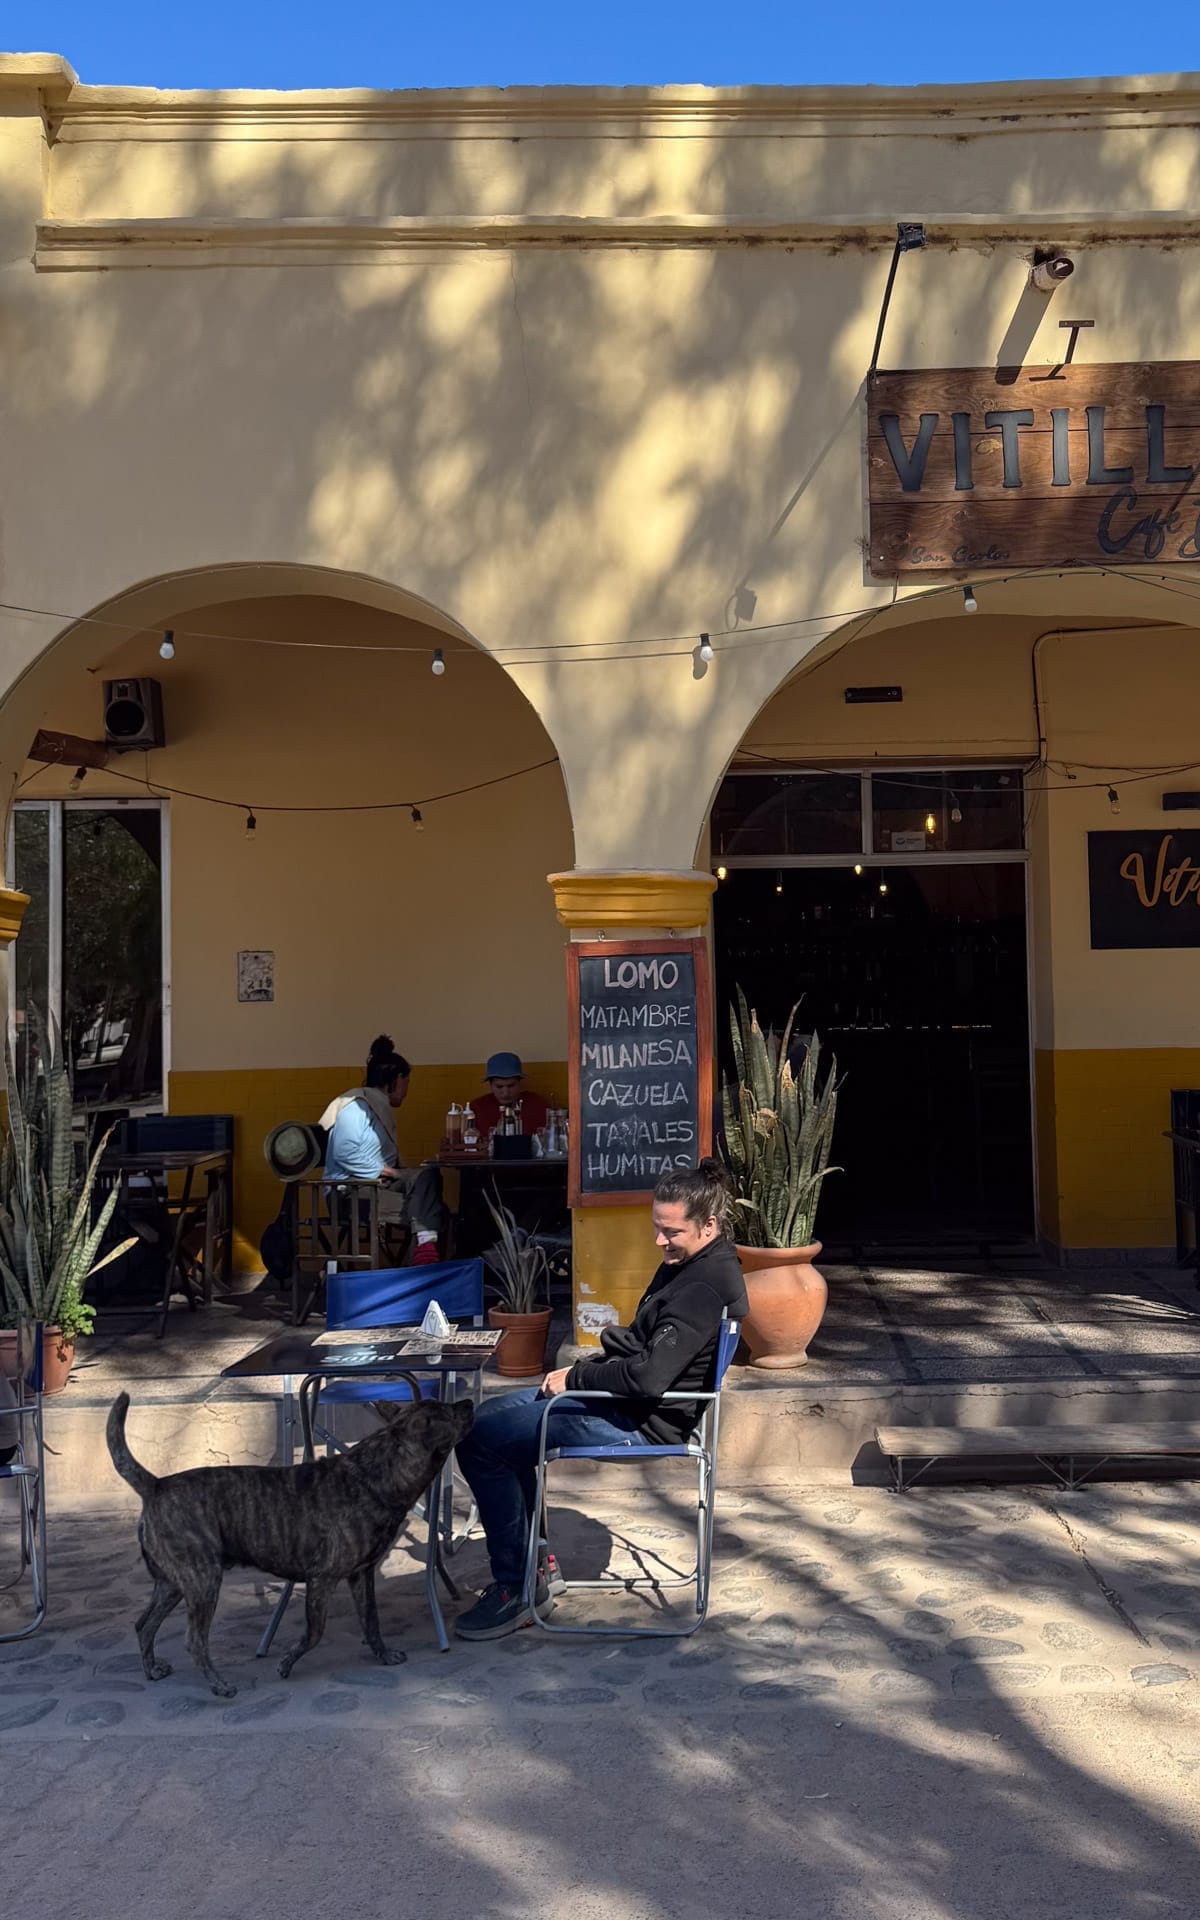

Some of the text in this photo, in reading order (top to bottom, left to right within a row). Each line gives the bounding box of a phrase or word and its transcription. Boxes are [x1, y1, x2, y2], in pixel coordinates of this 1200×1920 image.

[878, 405, 1194, 492] VITILL
[604, 959, 679, 990] LOMO
[580, 1003, 692, 1029] MATAMBRE
[581, 1039, 693, 1070] MILANESA
[588, 1079, 689, 1107] CAZUELA
